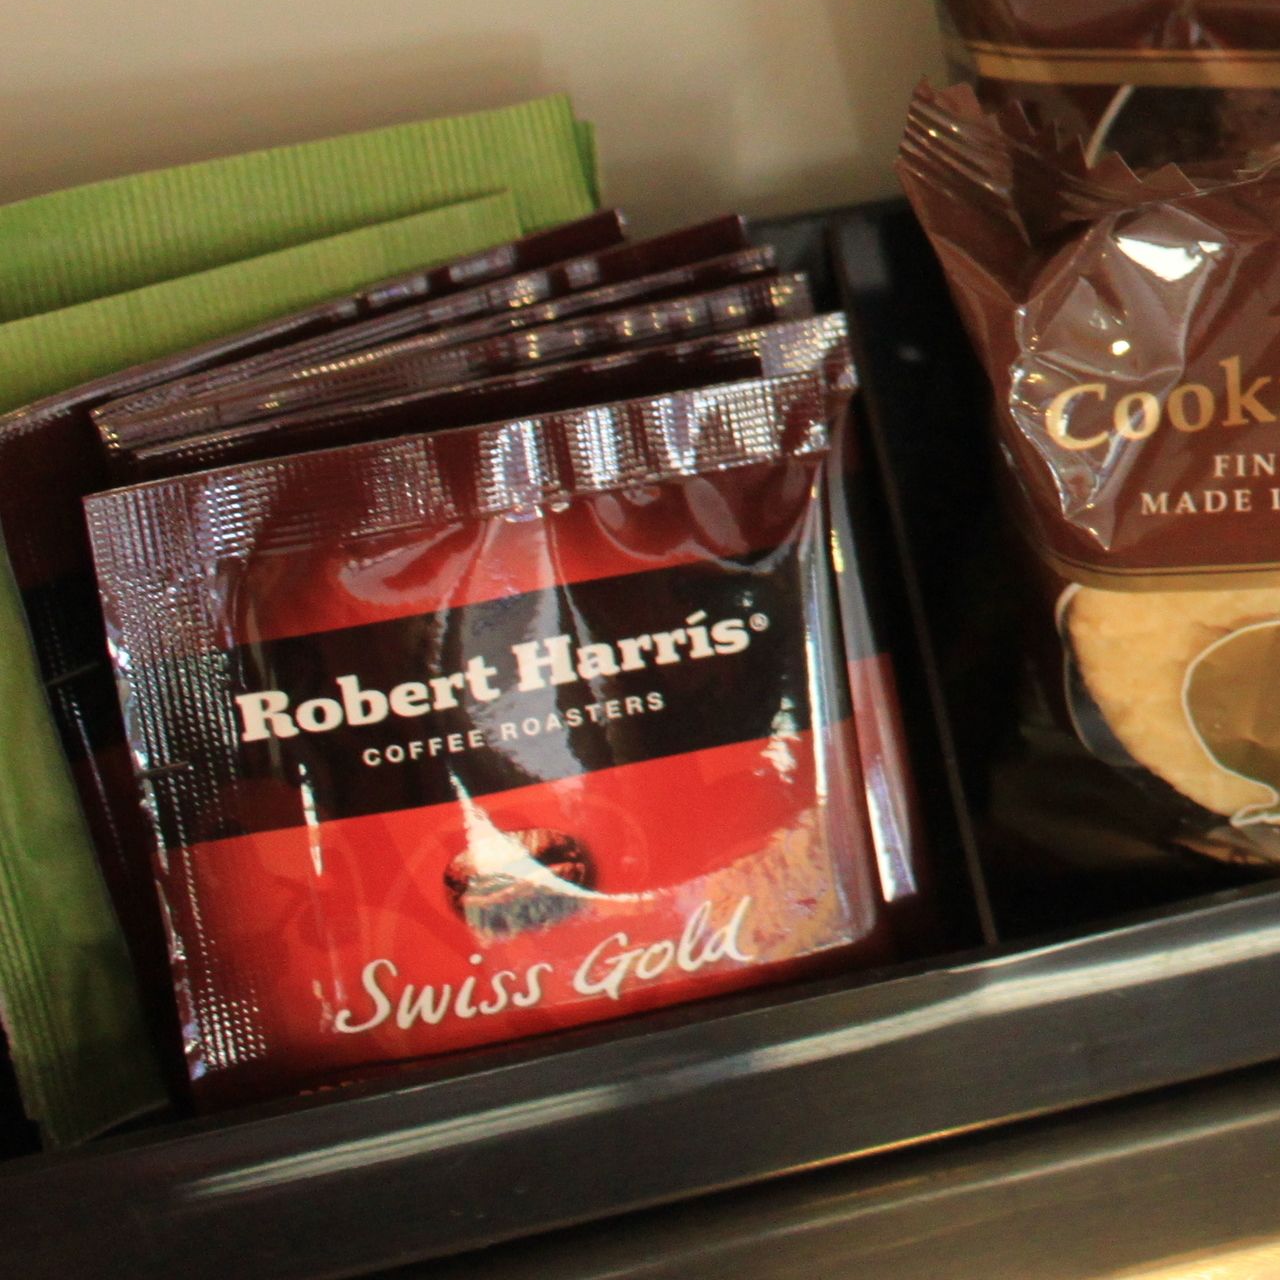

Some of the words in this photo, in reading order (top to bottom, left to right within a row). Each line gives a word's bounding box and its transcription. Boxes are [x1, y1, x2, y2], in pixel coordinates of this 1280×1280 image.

[1140, 488, 1254, 516] MADE
[235, 654, 501, 744] Robert
[361, 729, 487, 769] COFFEE
[500, 690, 668, 744] ROASTERS
[334, 953, 554, 1035] Swiss
[572, 894, 754, 1001] Gold
